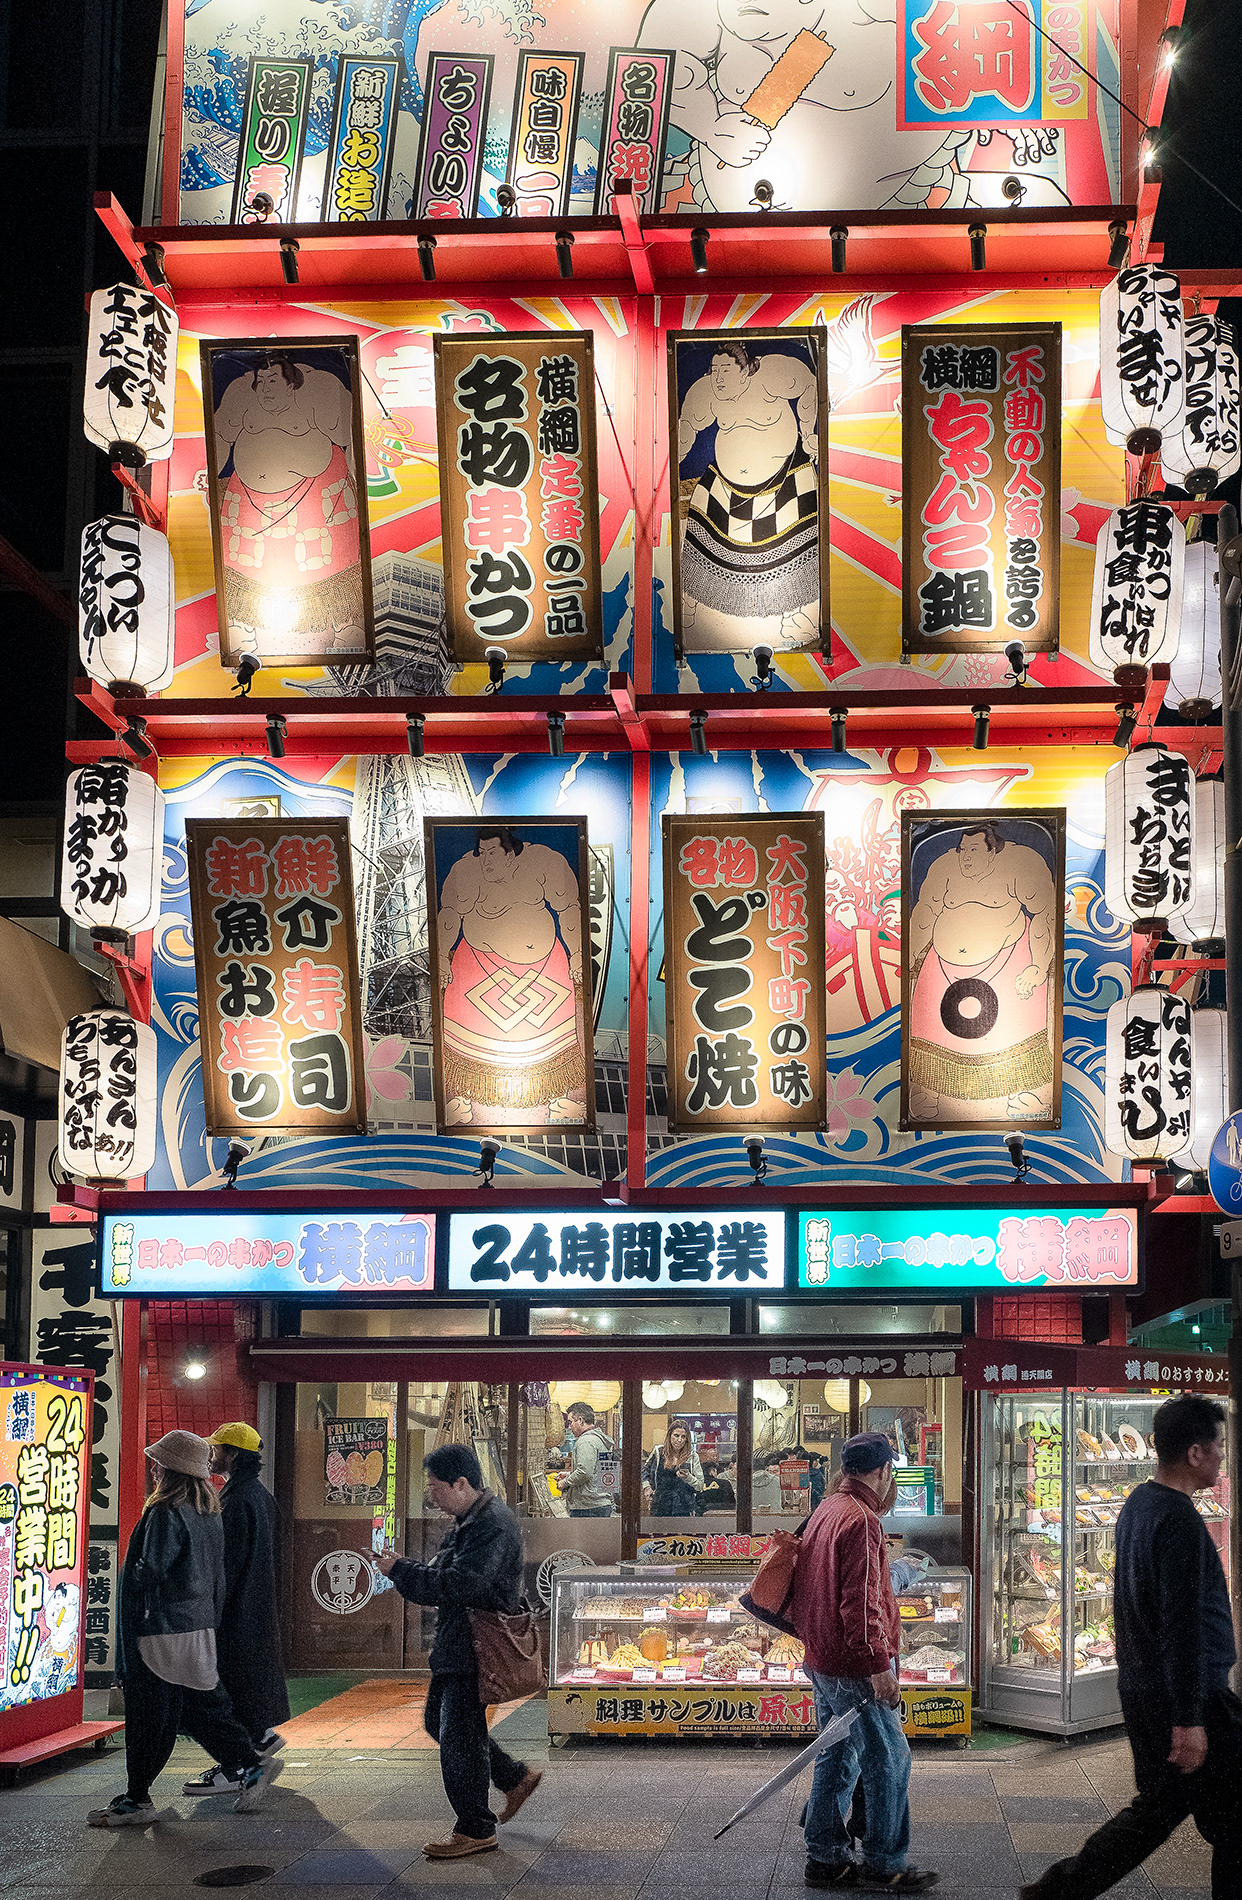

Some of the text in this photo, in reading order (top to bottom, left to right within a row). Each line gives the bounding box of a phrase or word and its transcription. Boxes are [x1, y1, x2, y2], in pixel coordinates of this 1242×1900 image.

[1046, 0, 1081, 106] の串かつ
[236, 70, 300, 222] 握り寿
[610, 63, 659, 215] 名物逸
[921, 345, 999, 391] 横綱
[455, 355, 535, 640] 名物串かつ
[536, 355, 588, 638] 横綱定番の一品
[920, 392, 995, 636] ちゃんこ鍋
[1003, 346, 1045, 632] 不動の人気を誇る
[679, 836, 757, 888] 名物
[766, 834, 813, 1109] 大阪下町の味
[282, 957, 351, 1114] 寿司
[137, 1221, 431, 1285] 日本一の串かつ 横綱
[470, 1221, 769, 1284] 24時間営業
[833, 1217, 1132, 1283] 日本一の串かつ 横綱
[769, 1351, 956, 1376] 日本一の串かつ 横綱
[983, 1363, 1018, 1382] 横綱
[327, 1421, 366, 1436] FRUIT
[328, 1433, 365, 1445] ICE BAR
[46, 1394, 87, 1572] 24時間
